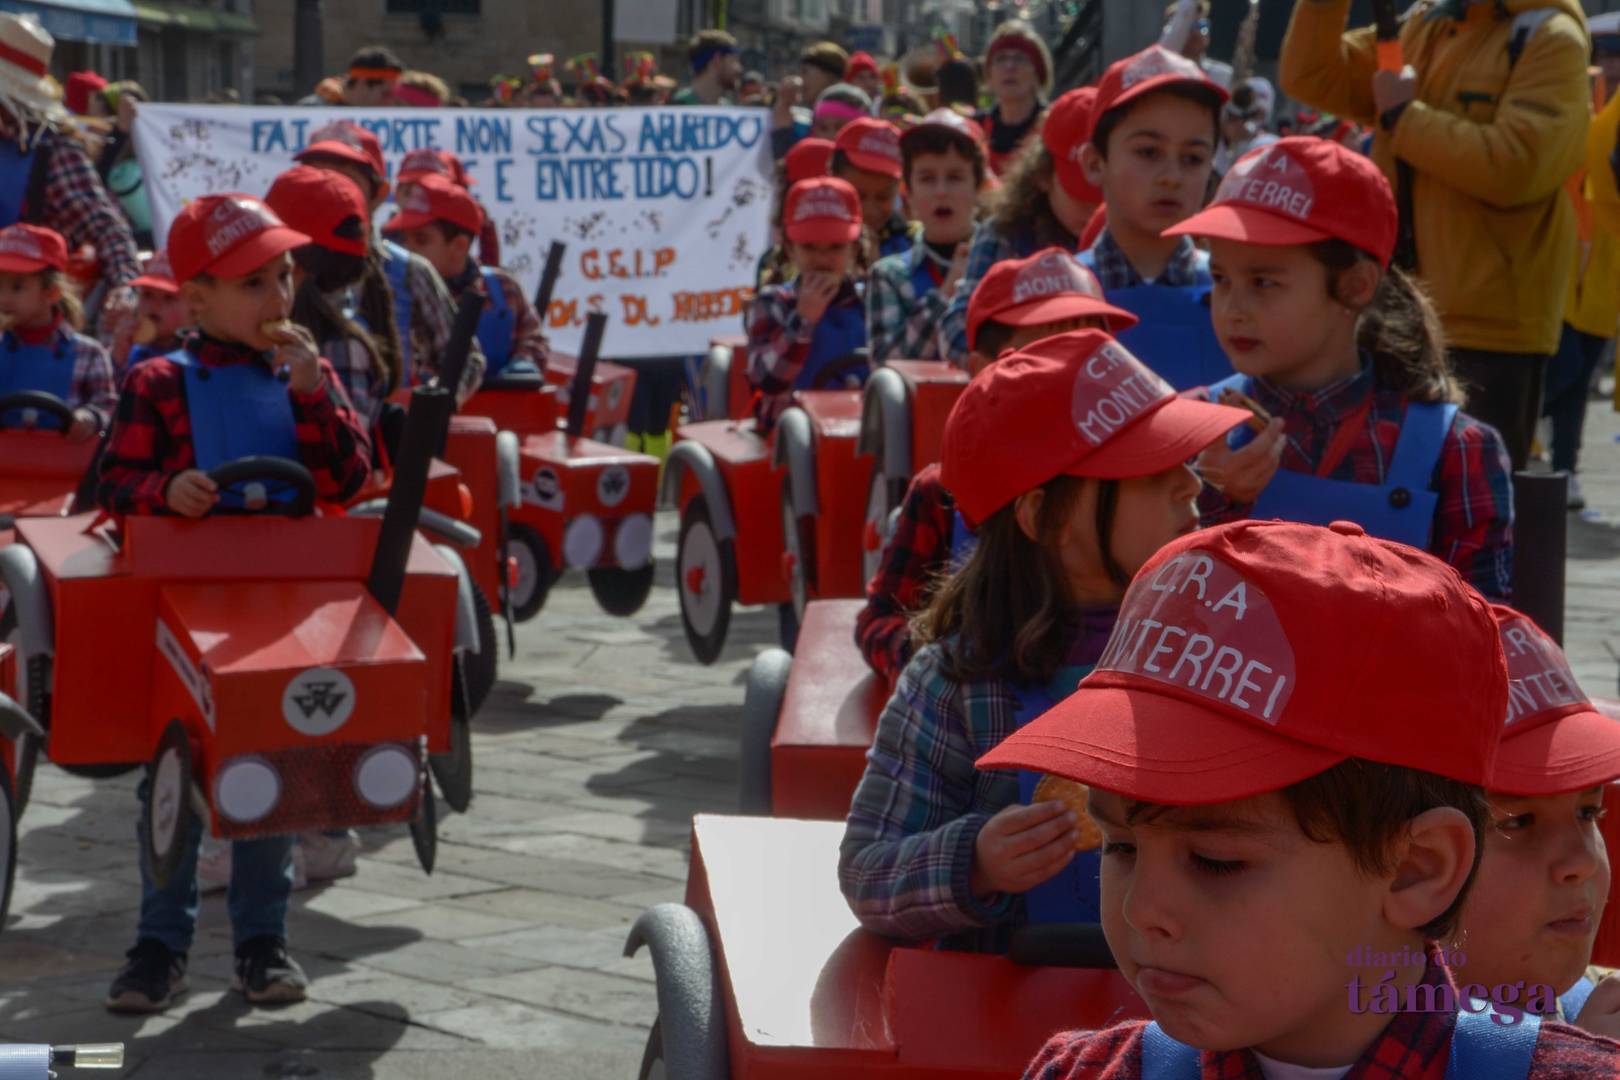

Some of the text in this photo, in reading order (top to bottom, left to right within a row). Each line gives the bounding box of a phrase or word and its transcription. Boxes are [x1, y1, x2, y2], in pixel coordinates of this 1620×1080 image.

[252, 119, 310, 153] FAI
[455, 116, 512, 153] NON
[526, 114, 627, 156] SEXAS
[1151, 555, 1248, 621] C.R.A
